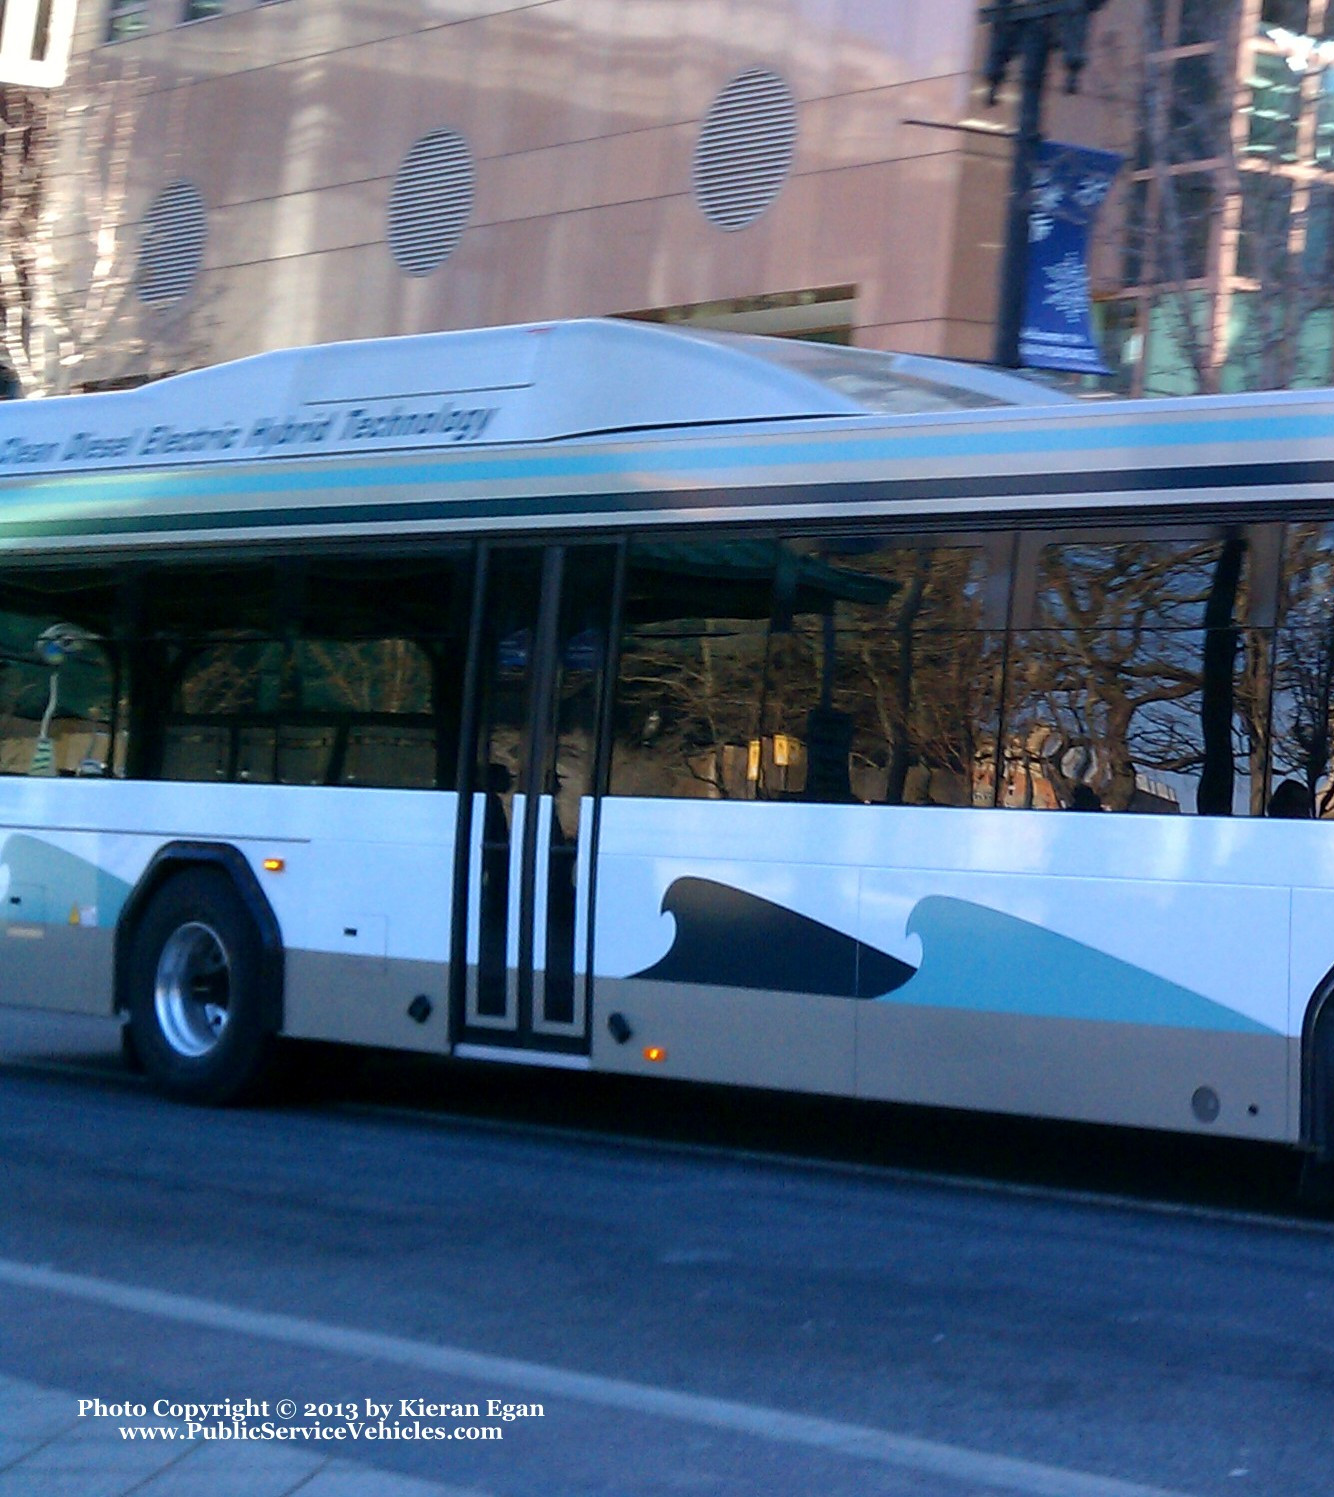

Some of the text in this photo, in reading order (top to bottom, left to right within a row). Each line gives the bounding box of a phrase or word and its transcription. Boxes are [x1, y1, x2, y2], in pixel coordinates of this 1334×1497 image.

[61, 428, 144, 461] Diesel
[138, 421, 243, 455] Electric
[243, 411, 337, 455] Hybrid
[338, 402, 500, 441] Technology
